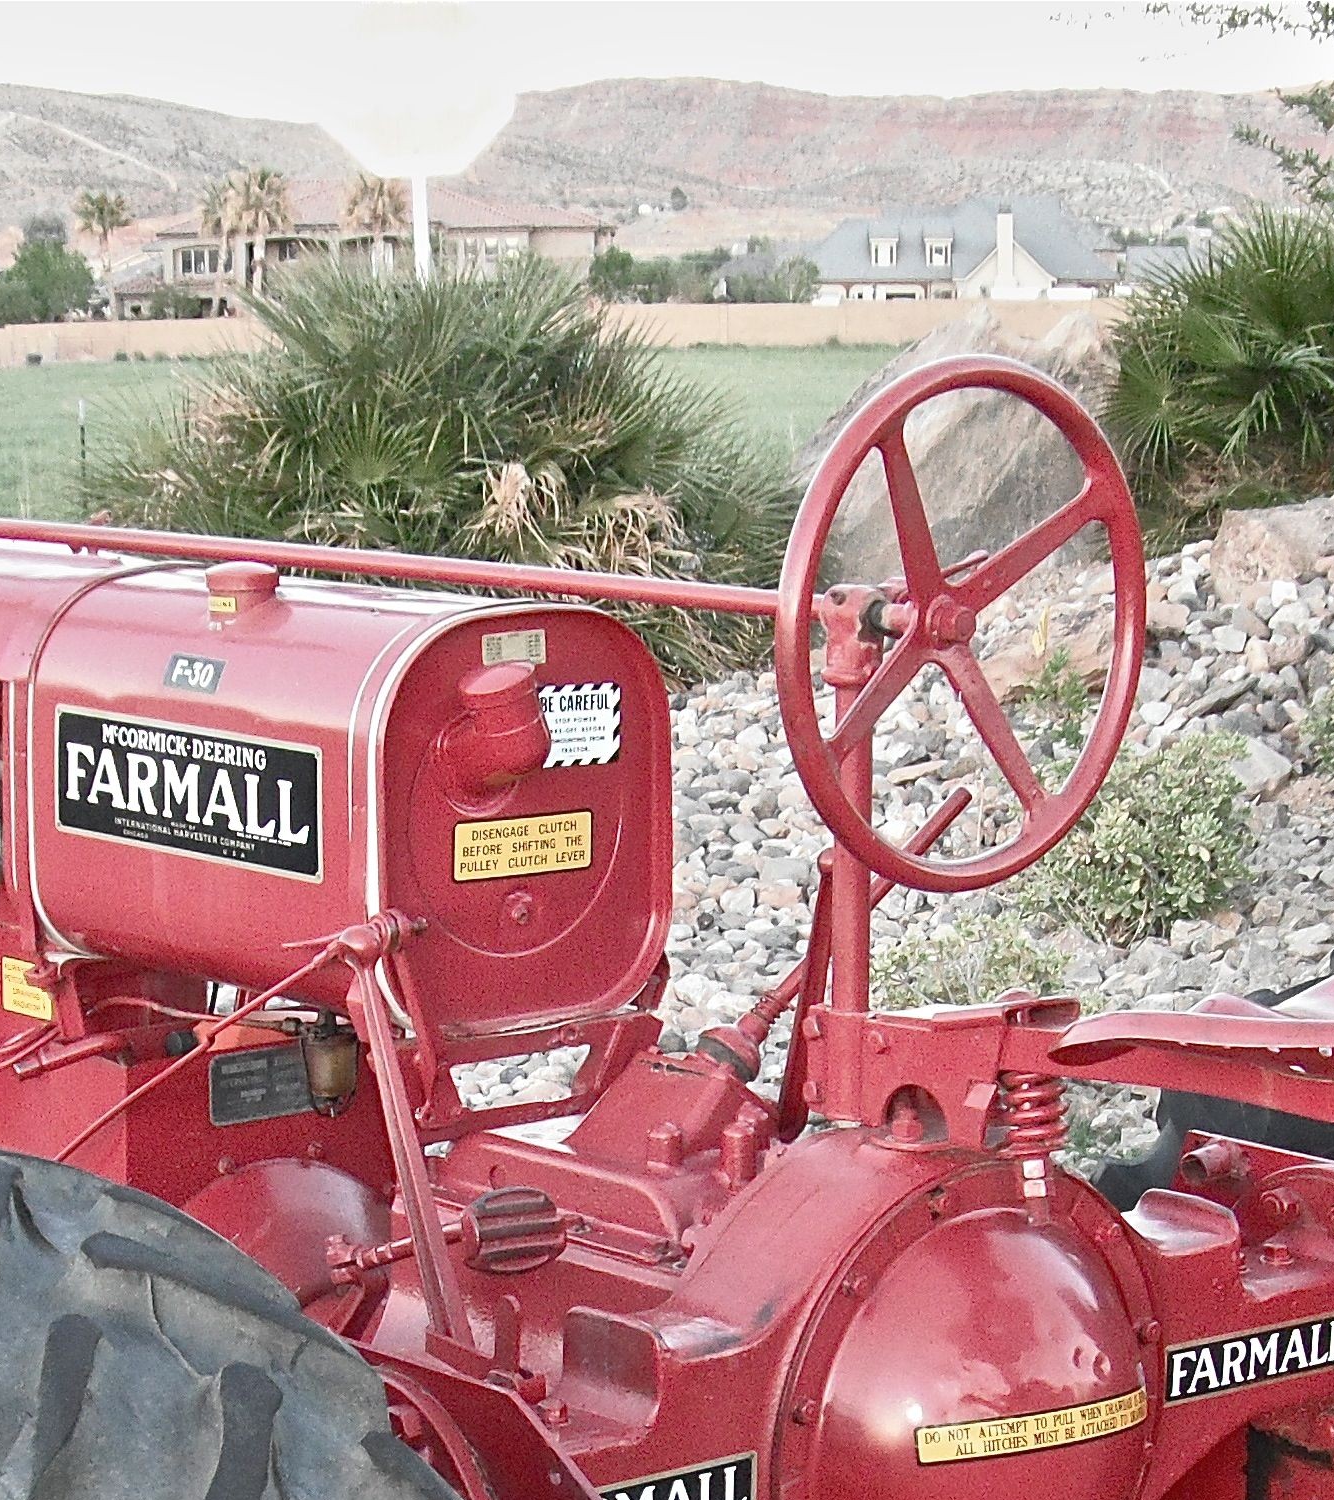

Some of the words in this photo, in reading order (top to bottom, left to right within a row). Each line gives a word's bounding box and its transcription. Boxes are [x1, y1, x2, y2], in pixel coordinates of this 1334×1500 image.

[171, 658, 215, 688] F-30
[540, 696, 554, 713] BE
[559, 693, 610, 712] CAREFUL
[65, 741, 310, 845] FARMALL
[114, 816, 172, 836] INTERNATIONAL
[173, 829, 218, 845] HARVESTER
[219, 836, 255, 851] COMPANY
[471, 825, 529, 841] DISENGAGE
[538, 820, 577, 834] CLUTCH
[462, 843, 503, 857] BEFORE
[512, 838, 556, 853] SHIFTING
[565, 835, 583, 848] THE
[460, 859, 499, 873] PULLEY
[508, 854, 548, 868] CLUTCH
[555, 850, 585, 863] LEVER
[924, 1431, 941, 1444] DO
[948, 1427, 970, 1442] NOT
[978, 1420, 1028, 1439] ATTEMPT
[1033, 1417, 1047, 1430] TO
[1053, 1411, 1075, 1427] PULL
[1080, 1406, 1102, 1421] WHEN
[955, 1442, 977, 1456] ALL
[983, 1435, 1028, 1453] HITCHES
[1033, 1429, 1059, 1445] MUST
[1065, 1427, 1075, 1440] BE
[1080, 1416, 1117, 1436] ATTACHED
